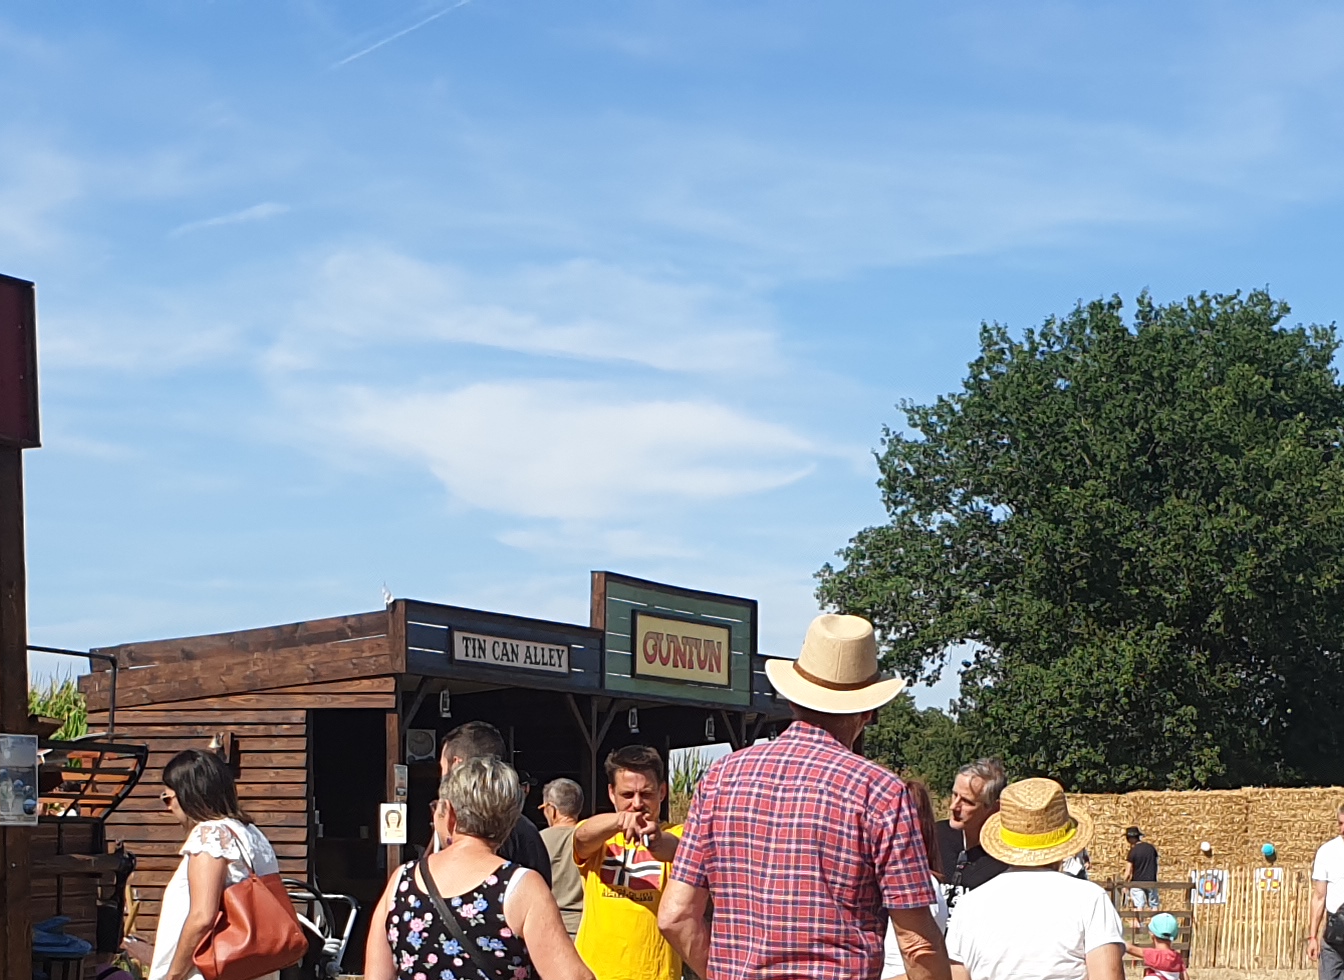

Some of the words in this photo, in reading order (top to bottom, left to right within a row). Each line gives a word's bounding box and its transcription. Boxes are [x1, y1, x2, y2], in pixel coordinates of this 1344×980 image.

[462, 636, 486, 659] TIN
[492, 641, 519, 663] CAN
[524, 645, 565, 668] ALLEY
[643, 631, 722, 673] GUNTUN
